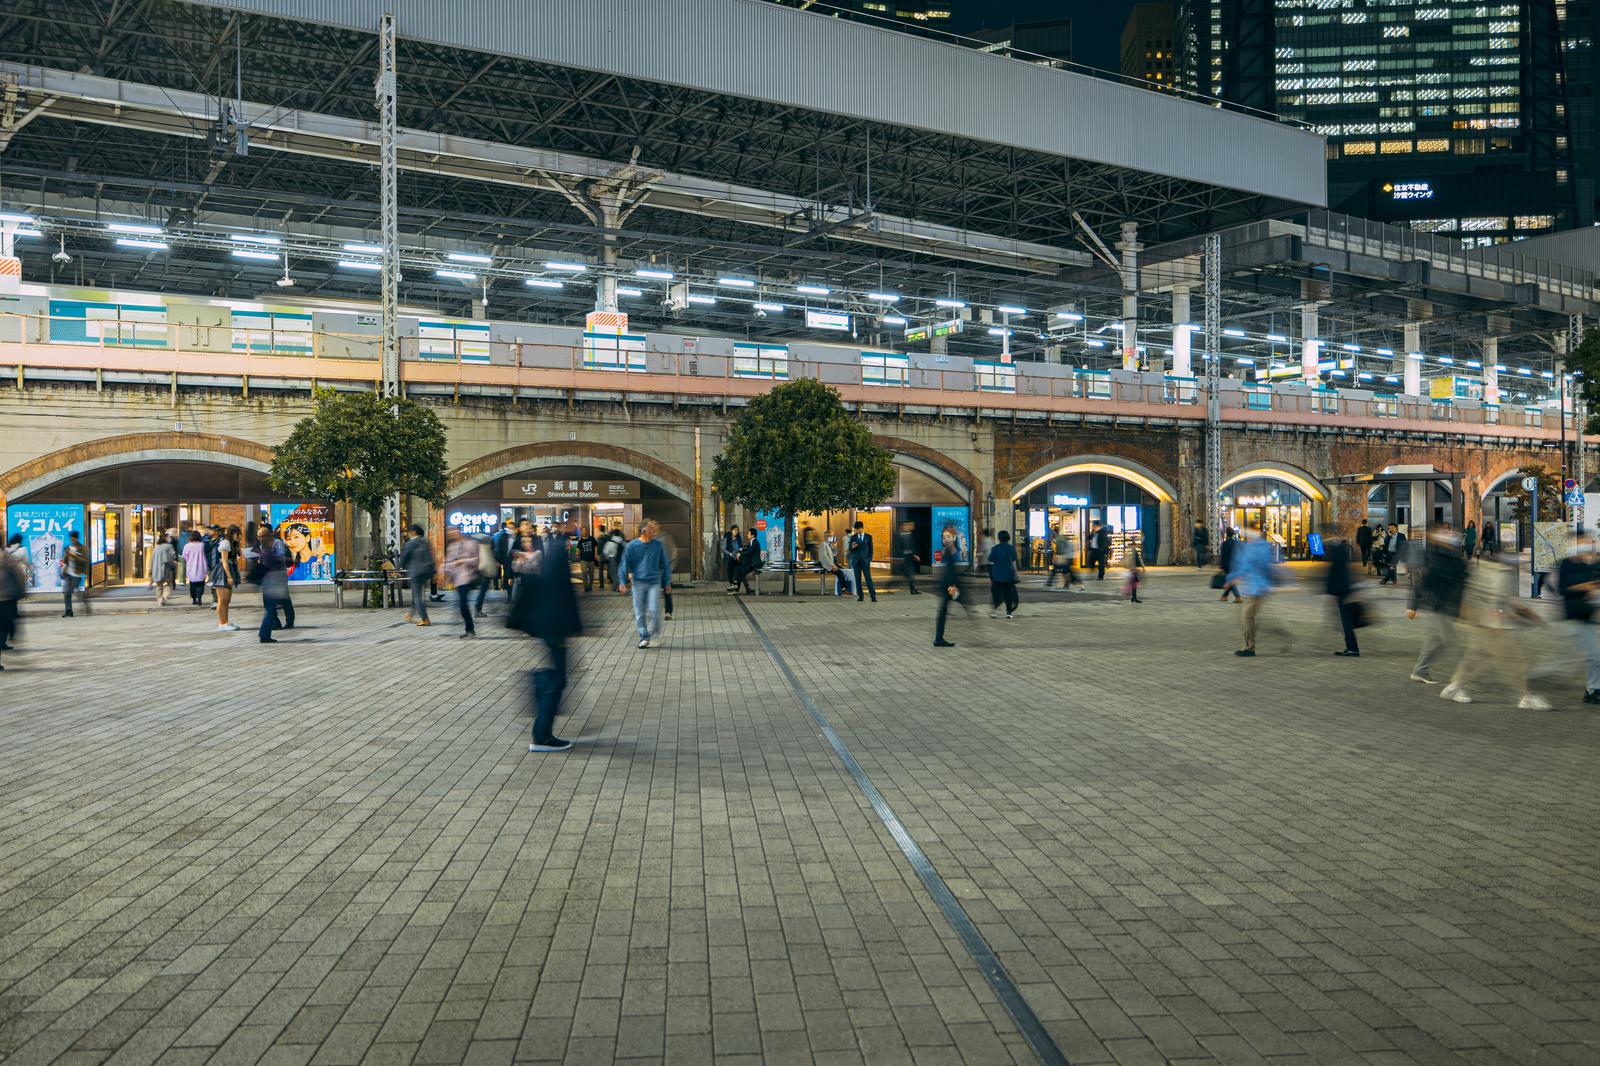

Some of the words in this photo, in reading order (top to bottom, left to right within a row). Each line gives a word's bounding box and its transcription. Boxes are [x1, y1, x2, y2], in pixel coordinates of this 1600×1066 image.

[522, 483, 537, 492] JR
[554, 481, 593, 490] 新橋駅
[16, 518, 75, 532] タコハイ
